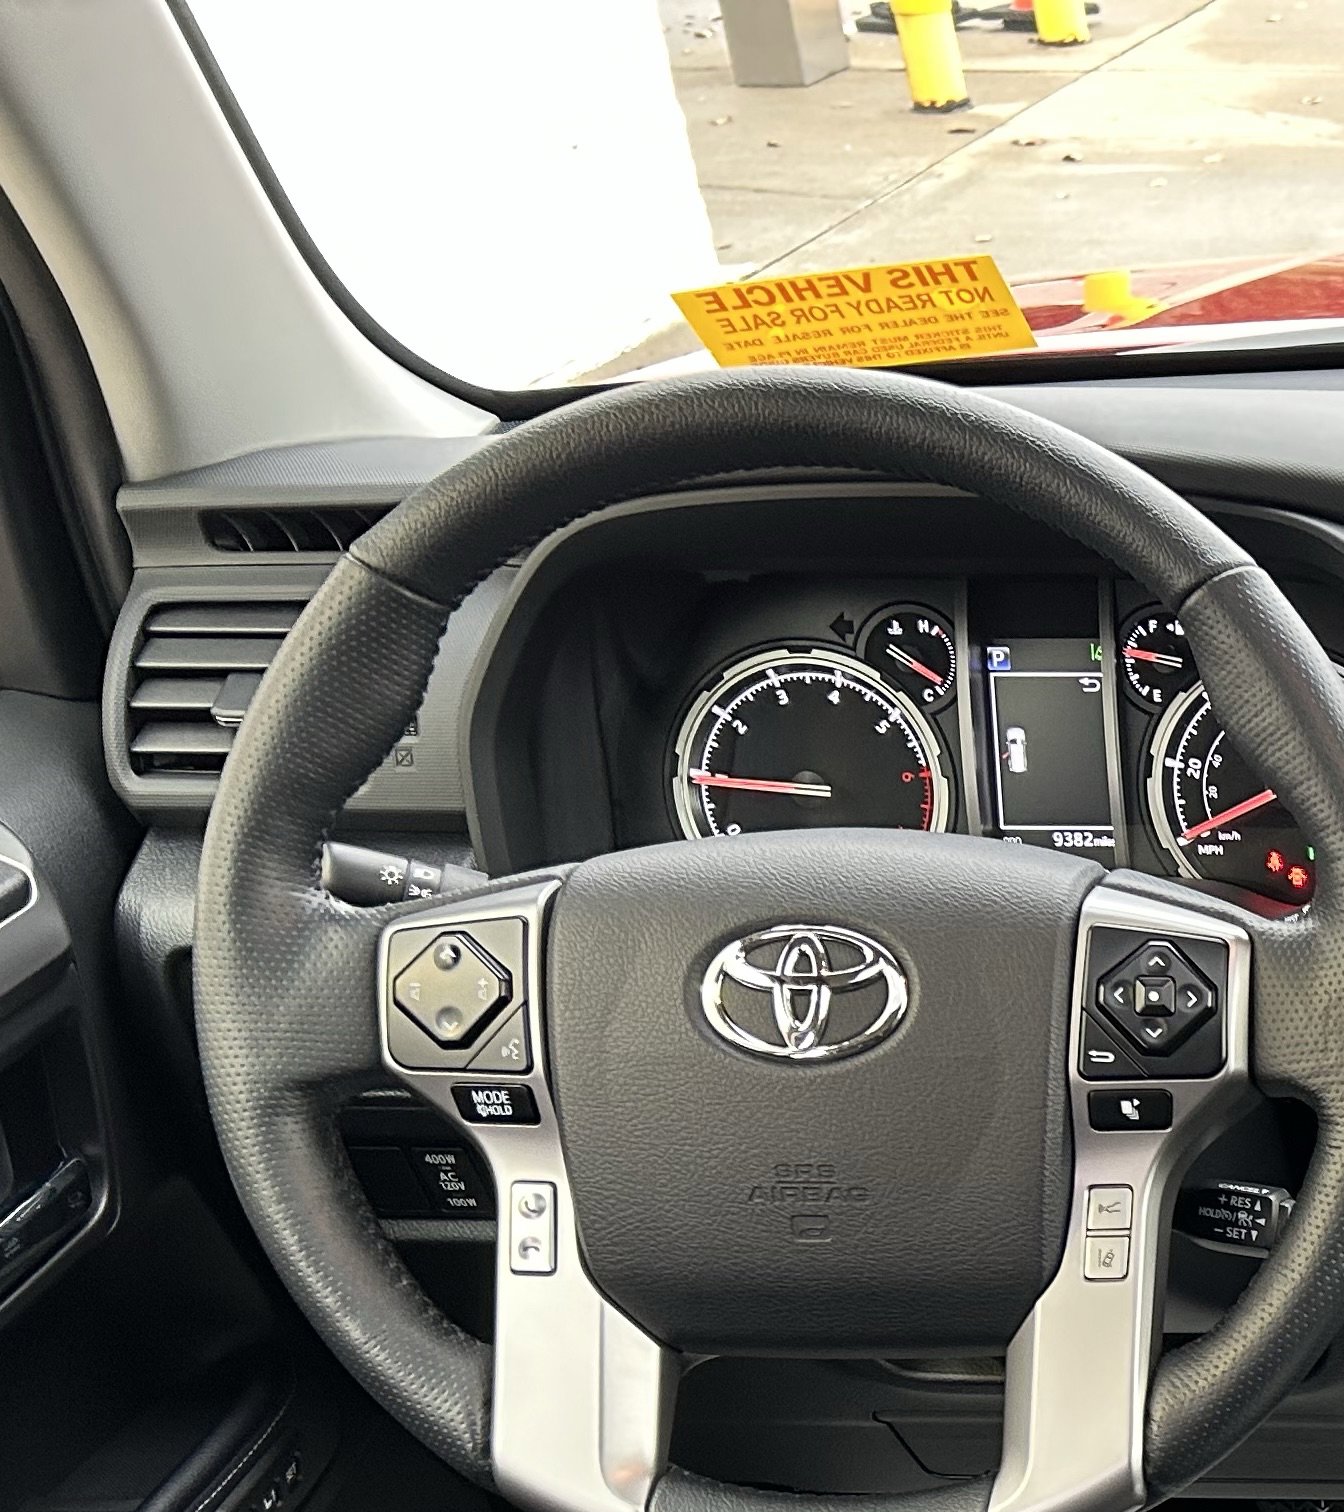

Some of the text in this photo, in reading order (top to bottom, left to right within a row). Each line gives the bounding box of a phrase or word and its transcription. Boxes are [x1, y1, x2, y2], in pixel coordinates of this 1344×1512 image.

[918, 620, 928, 633] H
[1148, 619, 1158, 633] F
[777, 689, 789, 706] 3
[827, 690, 840, 705] 4
[923, 689, 934, 702] C
[1152, 689, 1163, 703] E
[731, 719, 748, 736] 2
[874, 719, 890, 735] 5
[1211, 753, 1223, 769] 40
[1186, 758, 1202, 779] 20
[1208, 785, 1219, 799] 20
[1052, 832, 1094, 847] 9382
[1197, 845, 1224, 856] MPH
[471, 1090, 512, 1104] MODE
[487, 1105, 513, 1115] HOLD
[425, 1153, 456, 1165] 400W
[439, 1172, 459, 1182] AC
[439, 1181, 466, 1191] 120V
[447, 1198, 478, 1207] 100W
[1230, 1195, 1251, 1209] RES
[1226, 1227, 1248, 1240] SET
